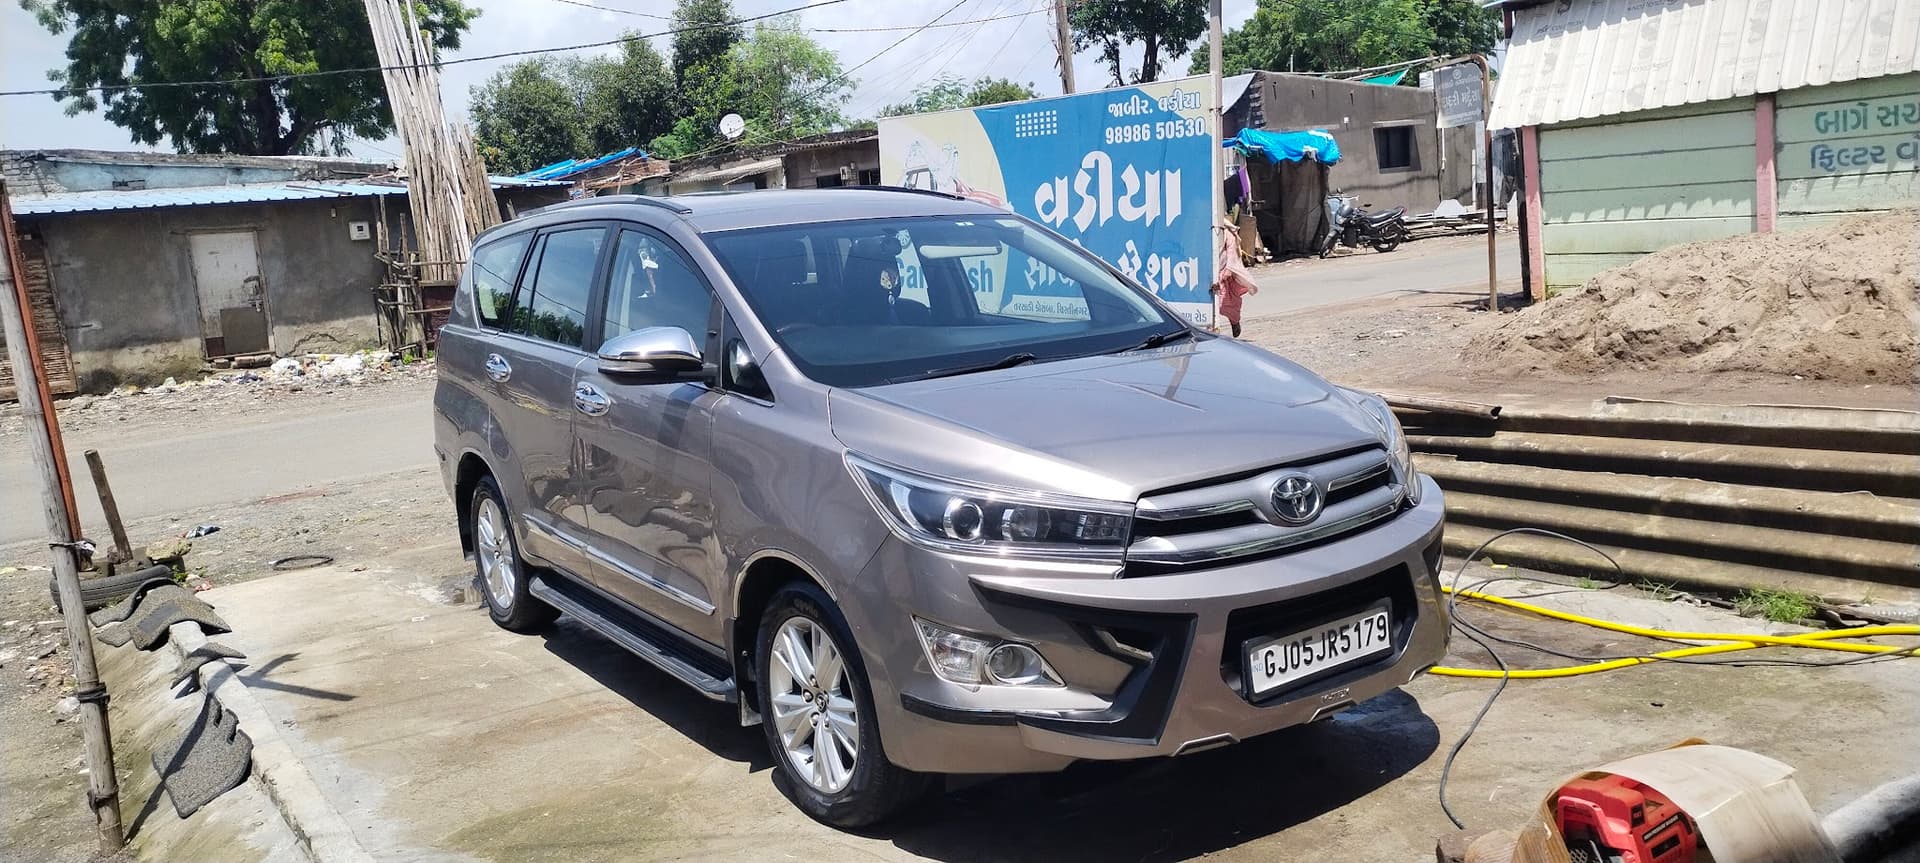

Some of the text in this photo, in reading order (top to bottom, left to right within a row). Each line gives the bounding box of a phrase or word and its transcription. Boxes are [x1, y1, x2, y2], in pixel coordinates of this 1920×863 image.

[1158, 88, 1200, 113] વડીયા
[1105, 116, 1207, 145] 98986 50530
[1810, 143, 1887, 173] ફિલ્ટર
[1034, 150, 1182, 234] વડીયા
[968, 260, 993, 293] sh
[1194, 307, 1208, 323] રોડ
[1264, 614, 1388, 678] GJ05JR5179
